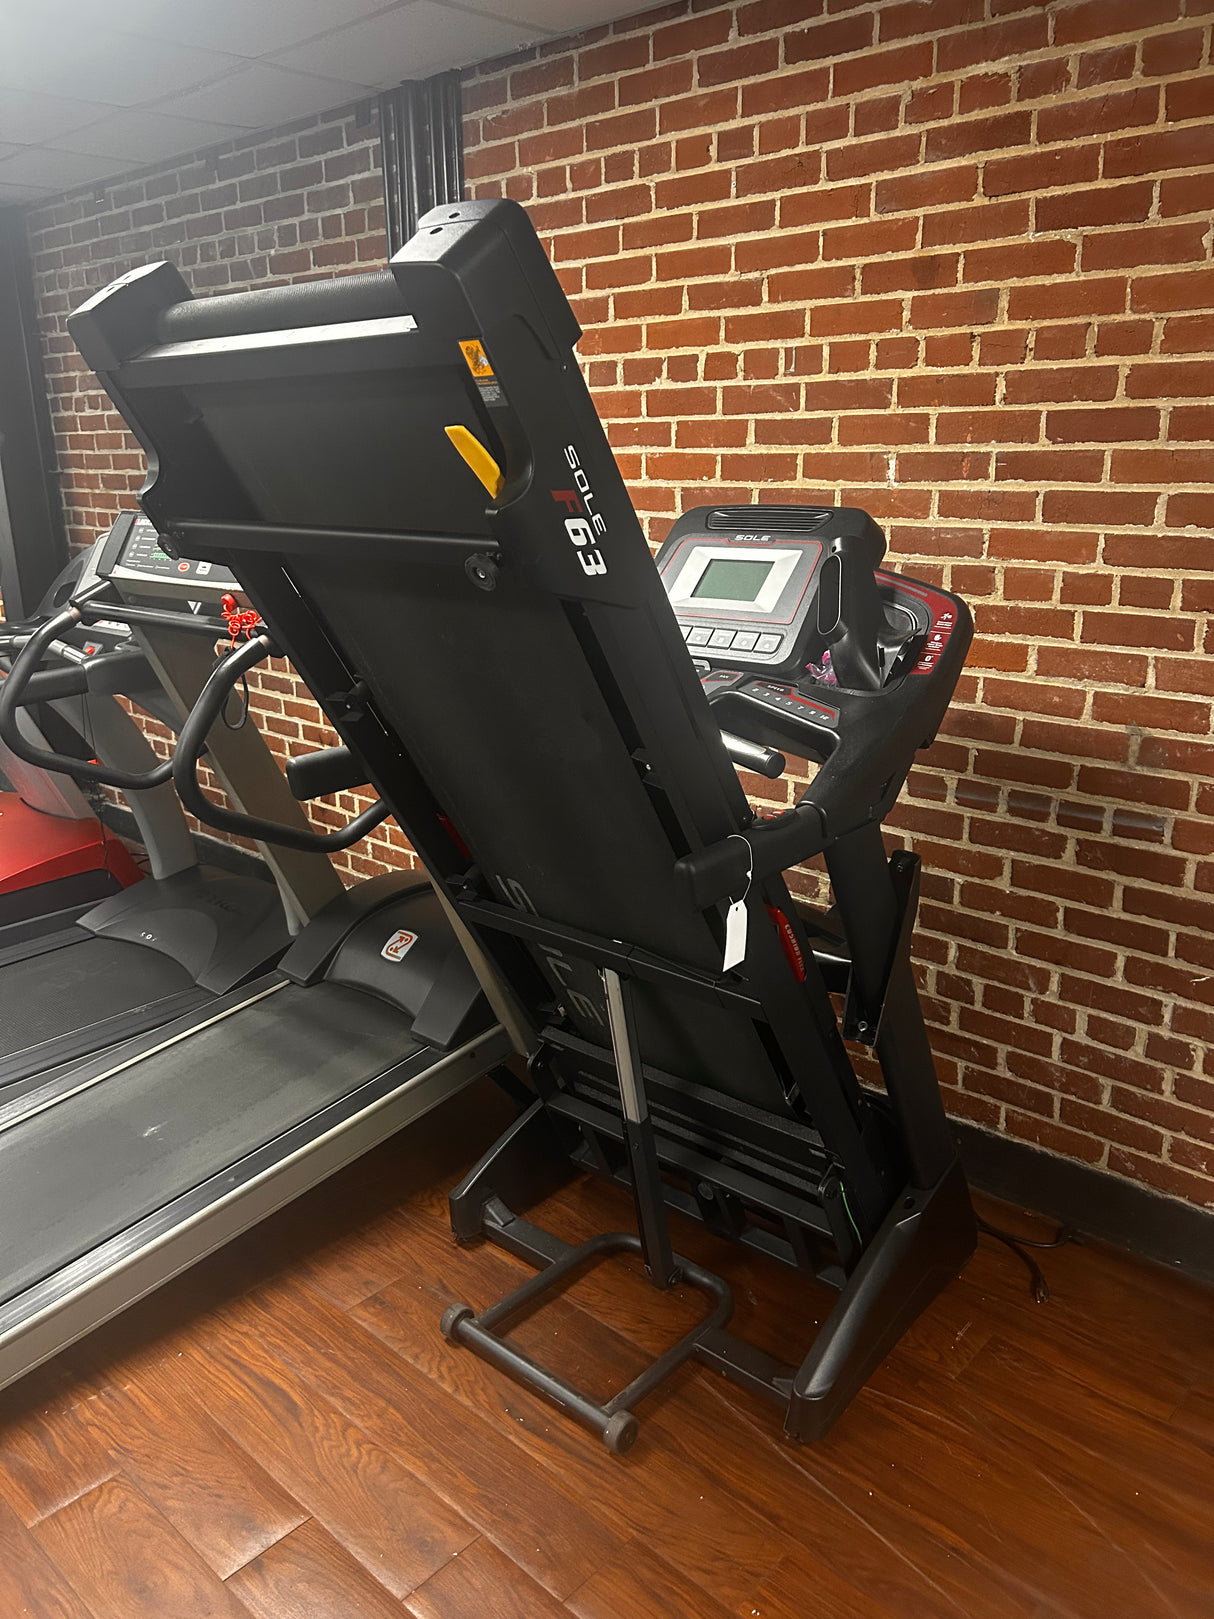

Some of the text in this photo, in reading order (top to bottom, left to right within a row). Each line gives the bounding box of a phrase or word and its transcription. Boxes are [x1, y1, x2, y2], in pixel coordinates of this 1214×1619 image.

[550, 489, 607, 576] F63
[564, 445, 607, 535] SOLE
[735, 534, 771, 542] SOLE
